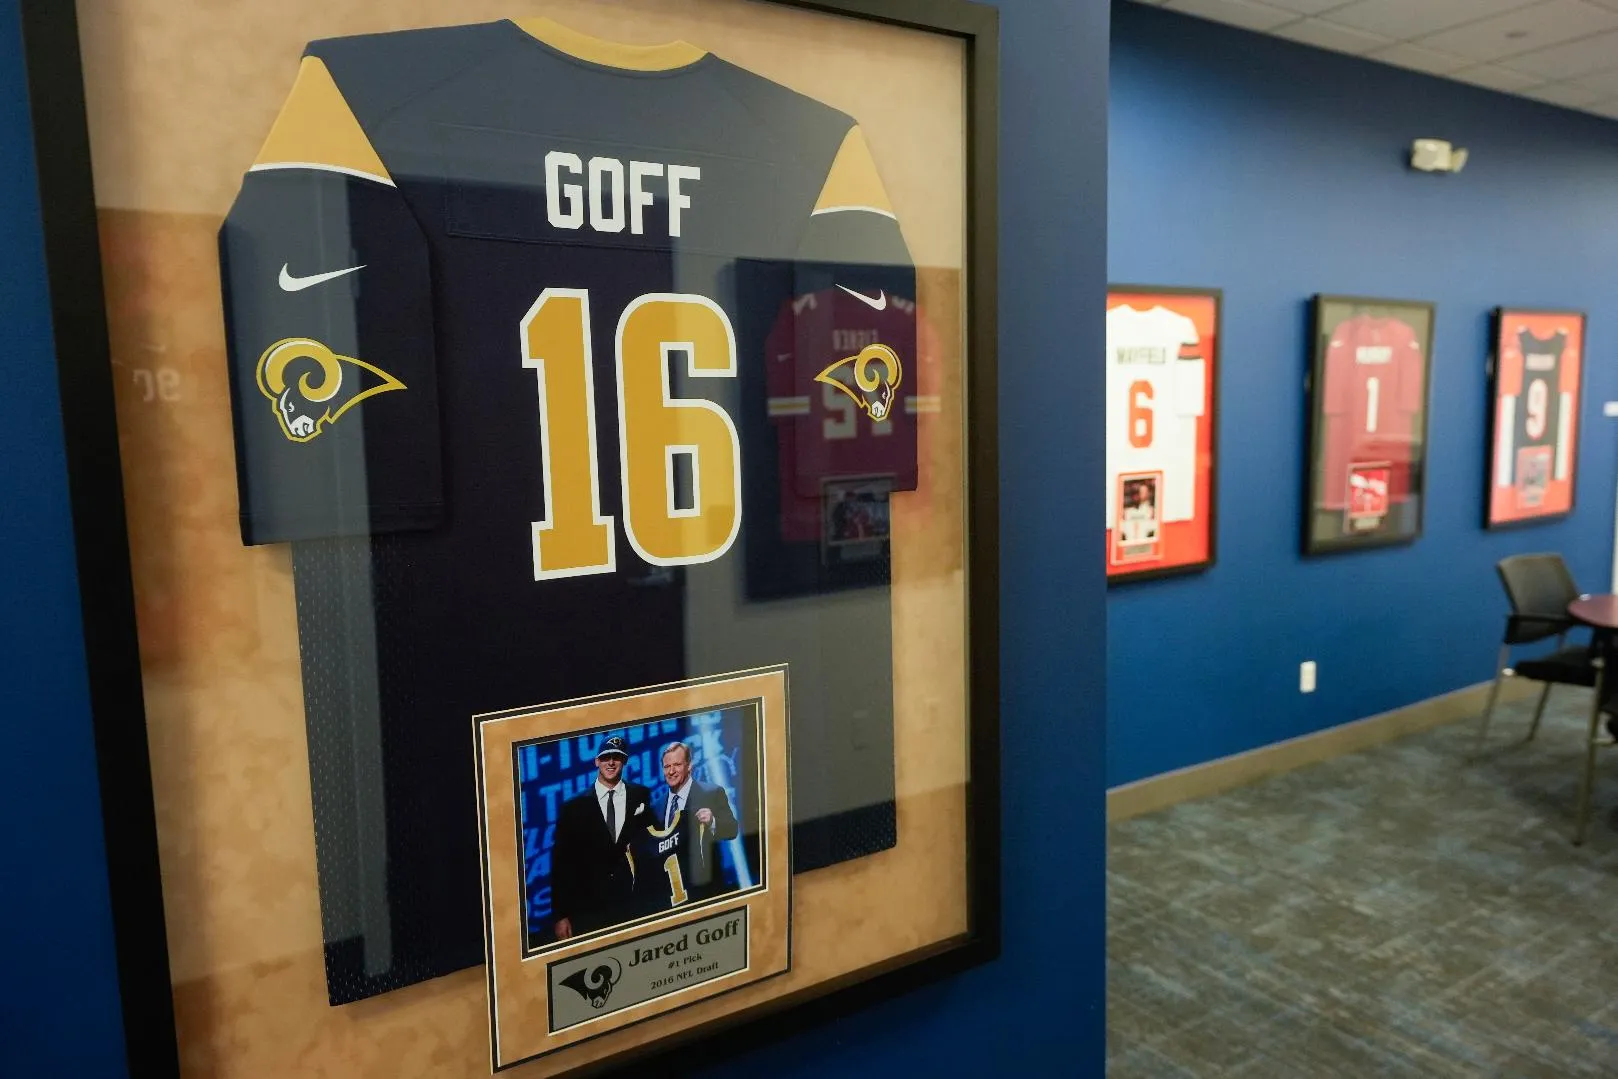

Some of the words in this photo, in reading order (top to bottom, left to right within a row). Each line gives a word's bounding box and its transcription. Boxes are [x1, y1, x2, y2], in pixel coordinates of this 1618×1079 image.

[545, 151, 701, 237] GOFF
[1128, 380, 1154, 448] 6
[1366, 377, 1380, 432] 1
[1526, 378, 1549, 439] 9
[520, 288, 742, 581] 16
[658, 832, 680, 853] GOFF
[664, 853, 688, 907] 1
[628, 934, 689, 967] Jared
[695, 918, 741, 945] Goff
[667, 959, 680, 969] #1
[683, 953, 703, 965] Pick
[650, 976, 674, 990] 2016
[676, 970, 693, 981] NFL
[696, 961, 719, 975] Draft
